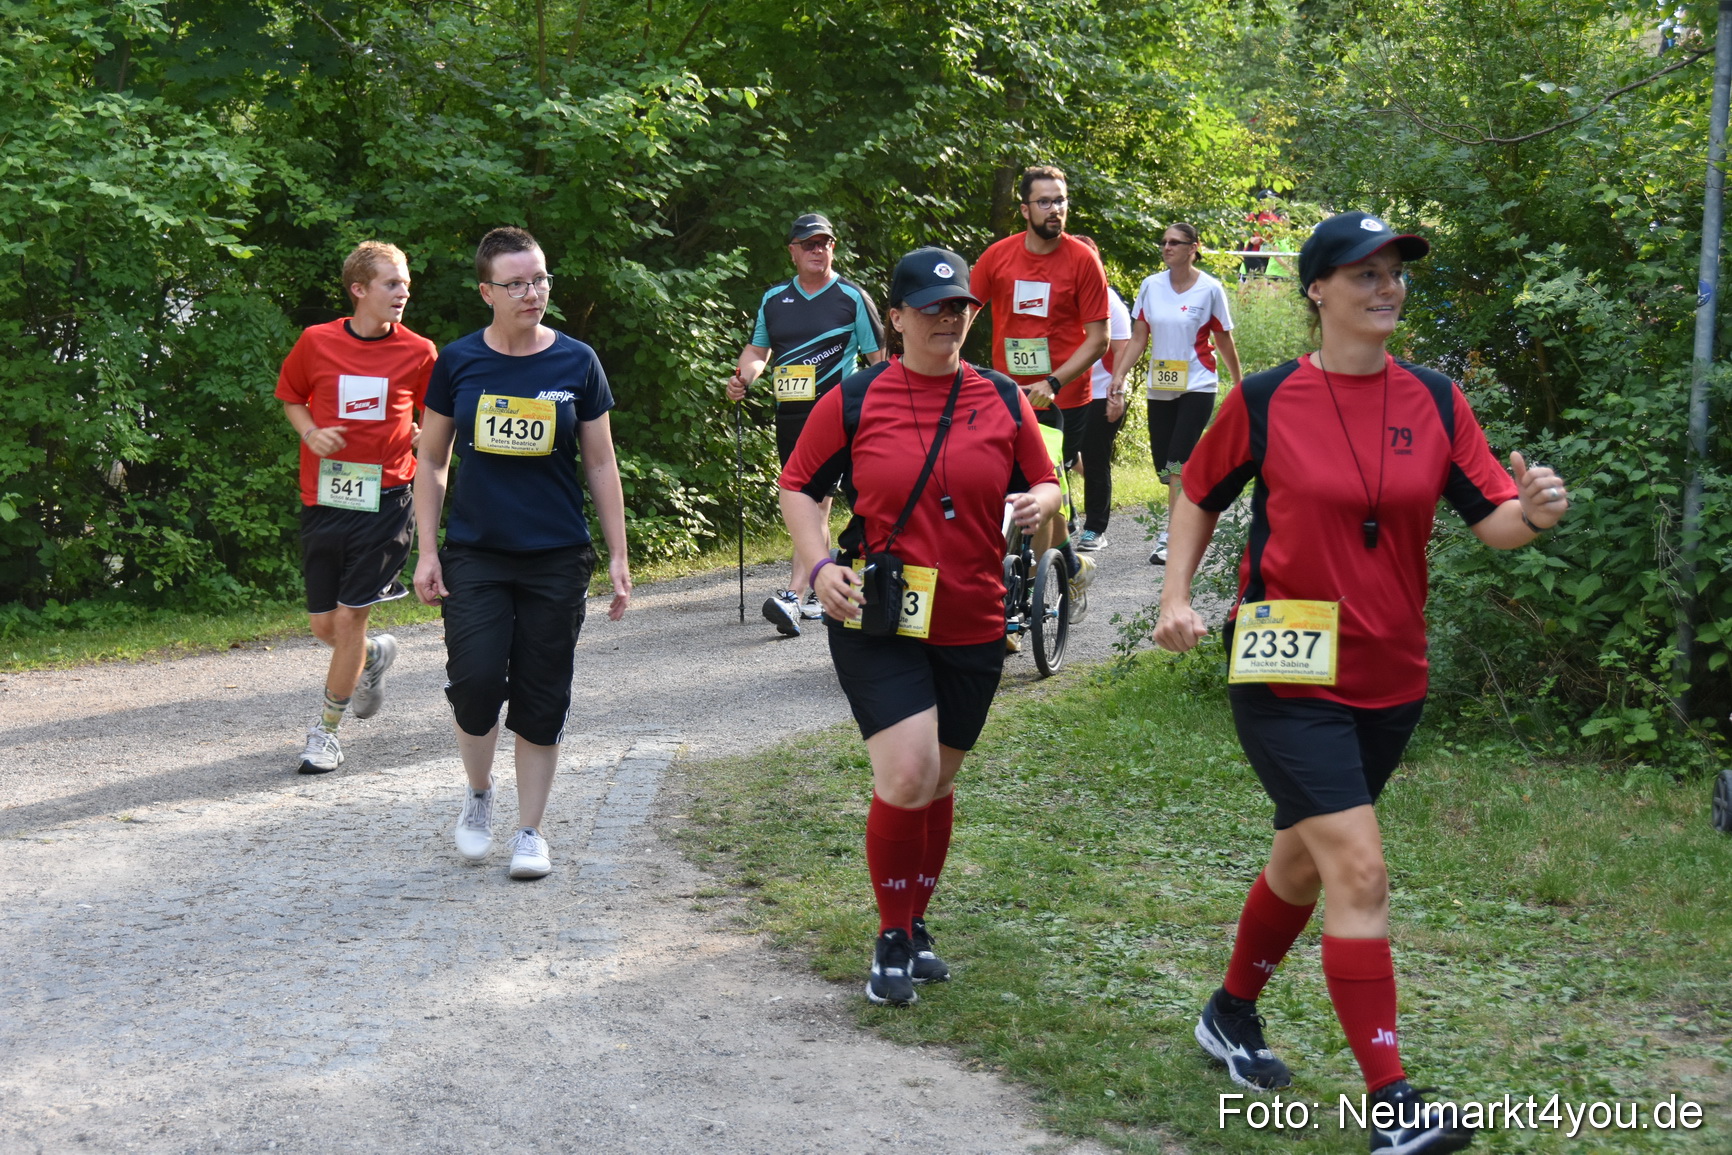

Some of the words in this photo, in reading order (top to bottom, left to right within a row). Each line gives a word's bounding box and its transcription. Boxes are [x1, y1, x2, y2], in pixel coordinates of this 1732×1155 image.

[802, 342, 843, 366] Donauer
[1014, 352, 1037, 365] 501
[777, 378, 809, 391] 2177
[1157, 371, 1178, 382] 368
[967, 409, 978, 425] 7
[486, 416, 544, 441] 1430
[1387, 426, 1413, 447] 79
[330, 478, 364, 498] 541
[1242, 630, 1321, 659] 2337
[1250, 660, 1277, 668] Hacker
[1280, 660, 1310, 669] Sabine
